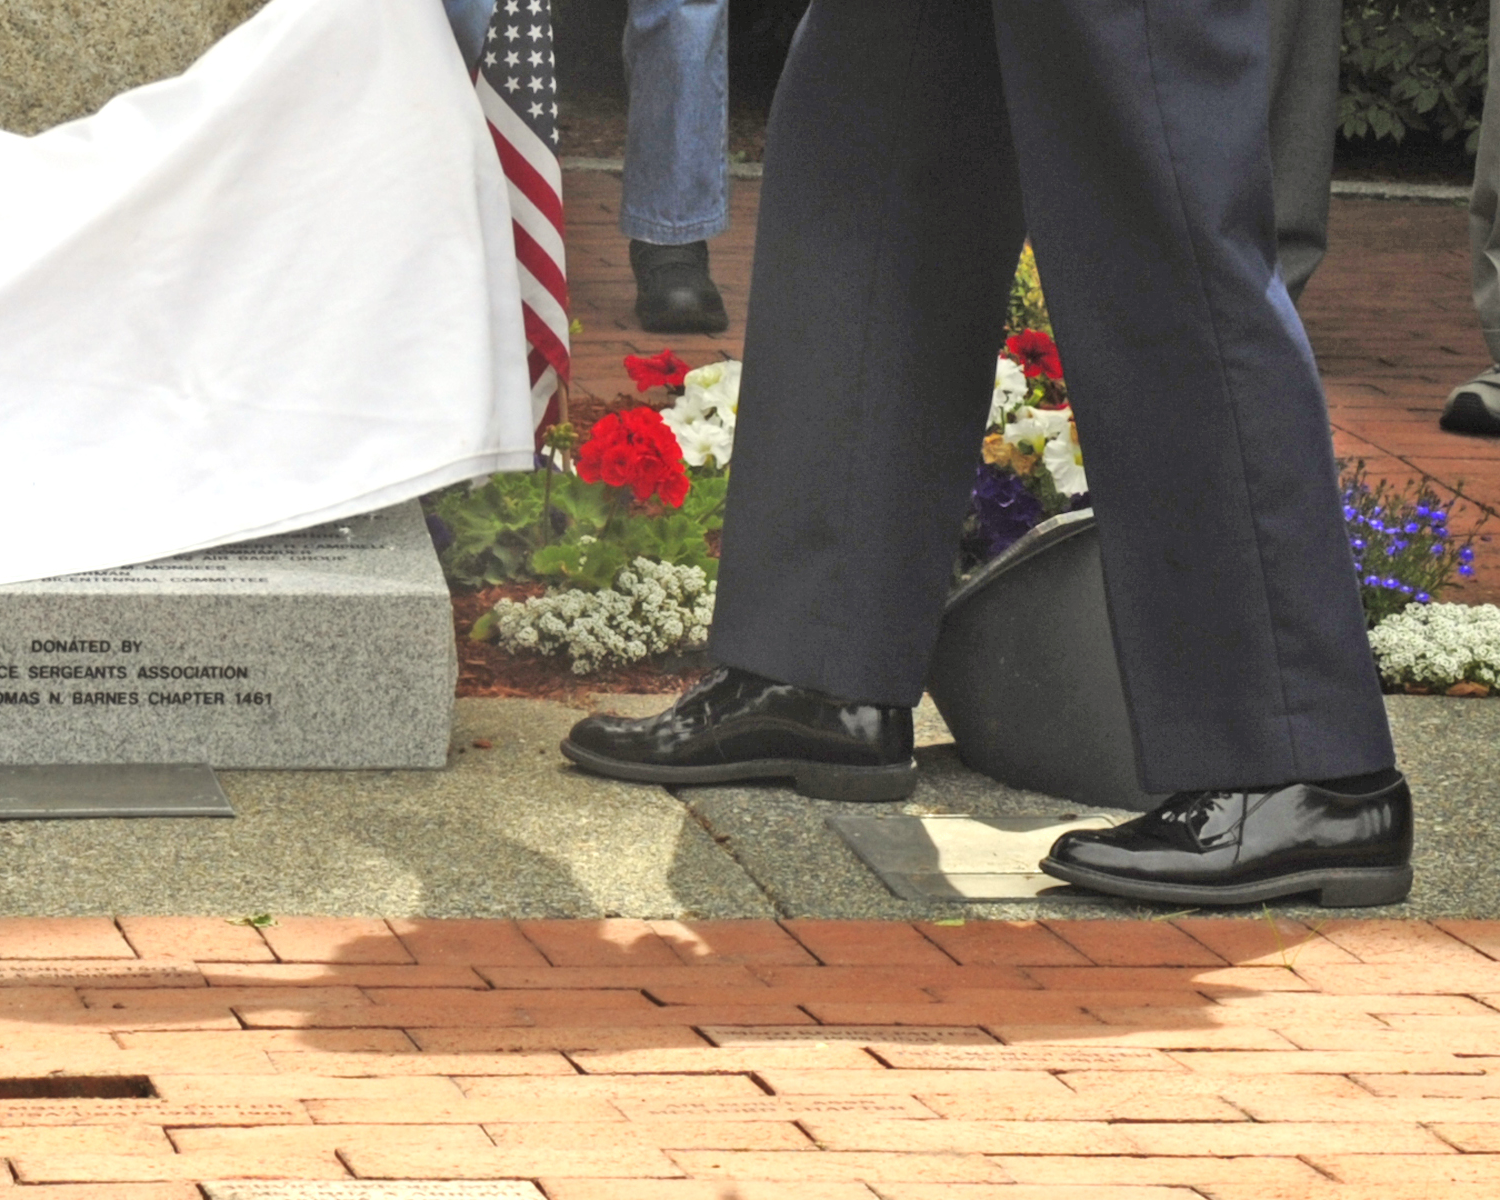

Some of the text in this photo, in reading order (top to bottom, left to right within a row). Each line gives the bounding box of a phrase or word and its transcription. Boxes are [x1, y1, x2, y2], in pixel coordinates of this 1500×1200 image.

[31, 640, 143, 653] DONATED BY
[28, 666, 127, 679] SERGEANTS
[136, 666, 248, 679] ASSOCIATION
[49, 692, 64, 705] N.
[72, 691, 139, 705] BARNES
[148, 691, 225, 705] CHAPTER
[235, 691, 272, 705] 1461
